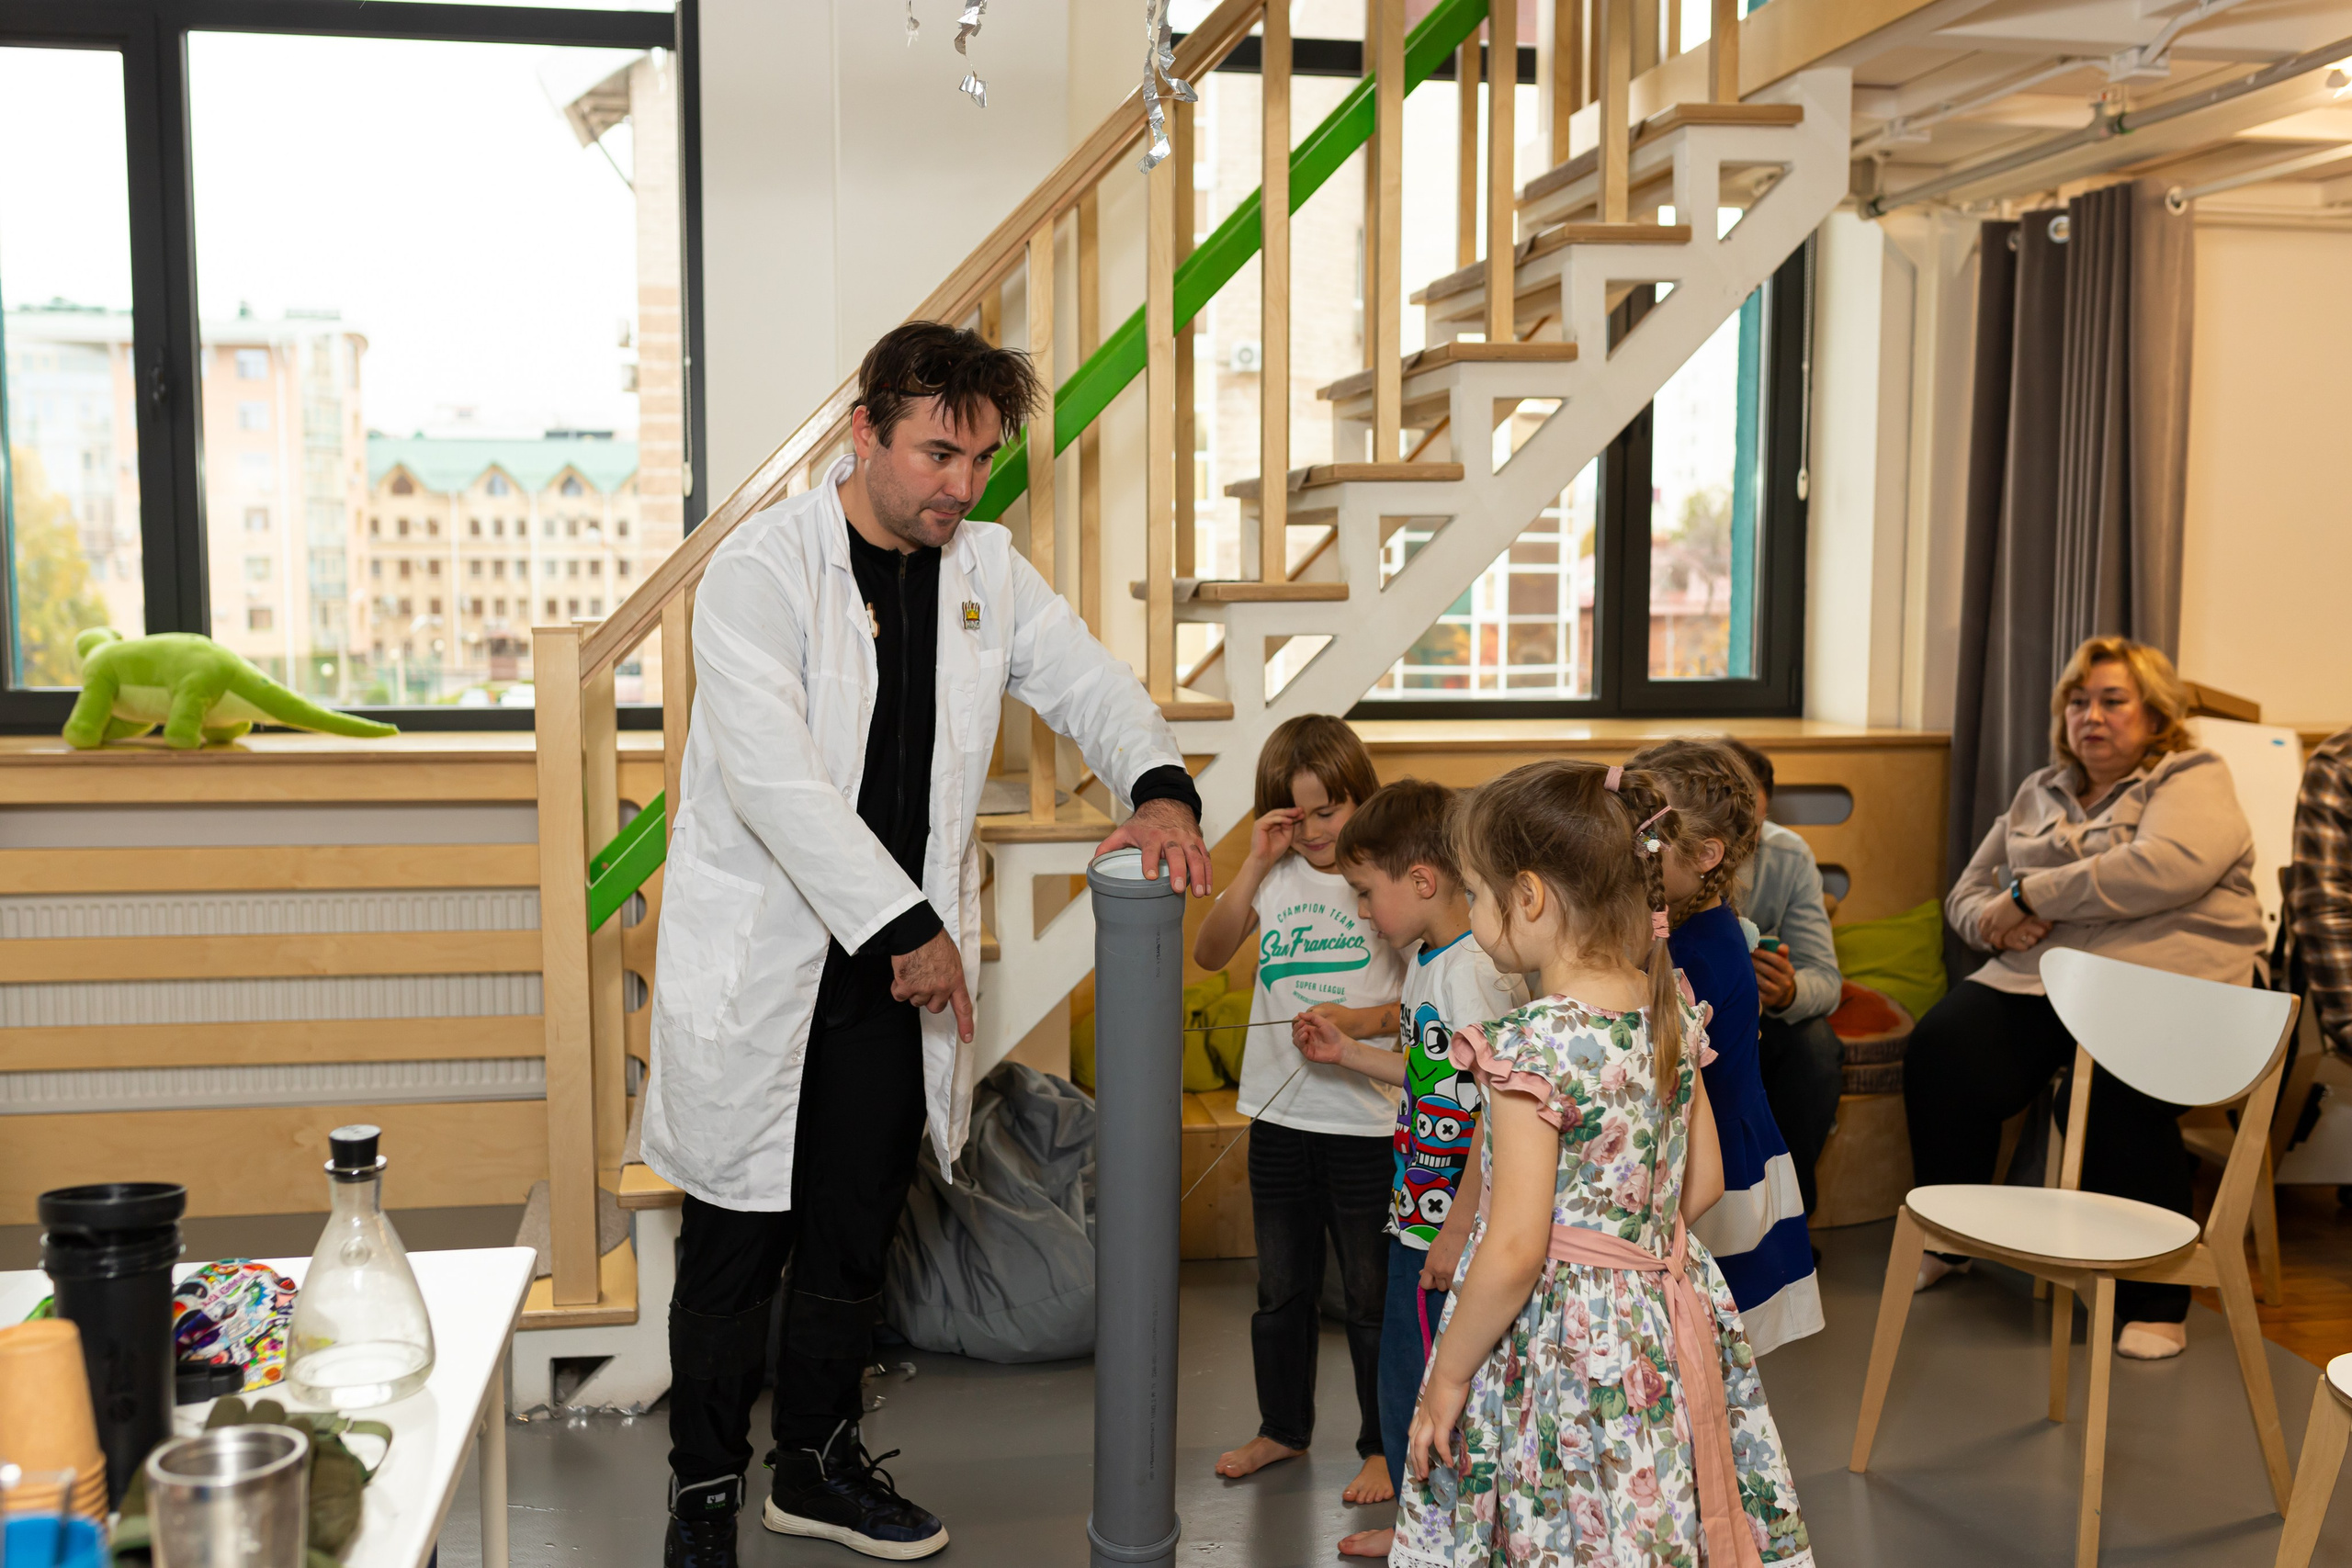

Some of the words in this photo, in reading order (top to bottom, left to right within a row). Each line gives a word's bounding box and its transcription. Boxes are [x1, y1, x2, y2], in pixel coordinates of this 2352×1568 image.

[1277, 903, 1326, 923] CHAMPION
[1329, 908, 1355, 931] TEAM
[1259, 930, 1291, 964] San
[1290, 924, 1365, 958] Francisco
[1295, 980, 1317, 991] SUPER
[1318, 984, 1345, 996] LEAGUE
